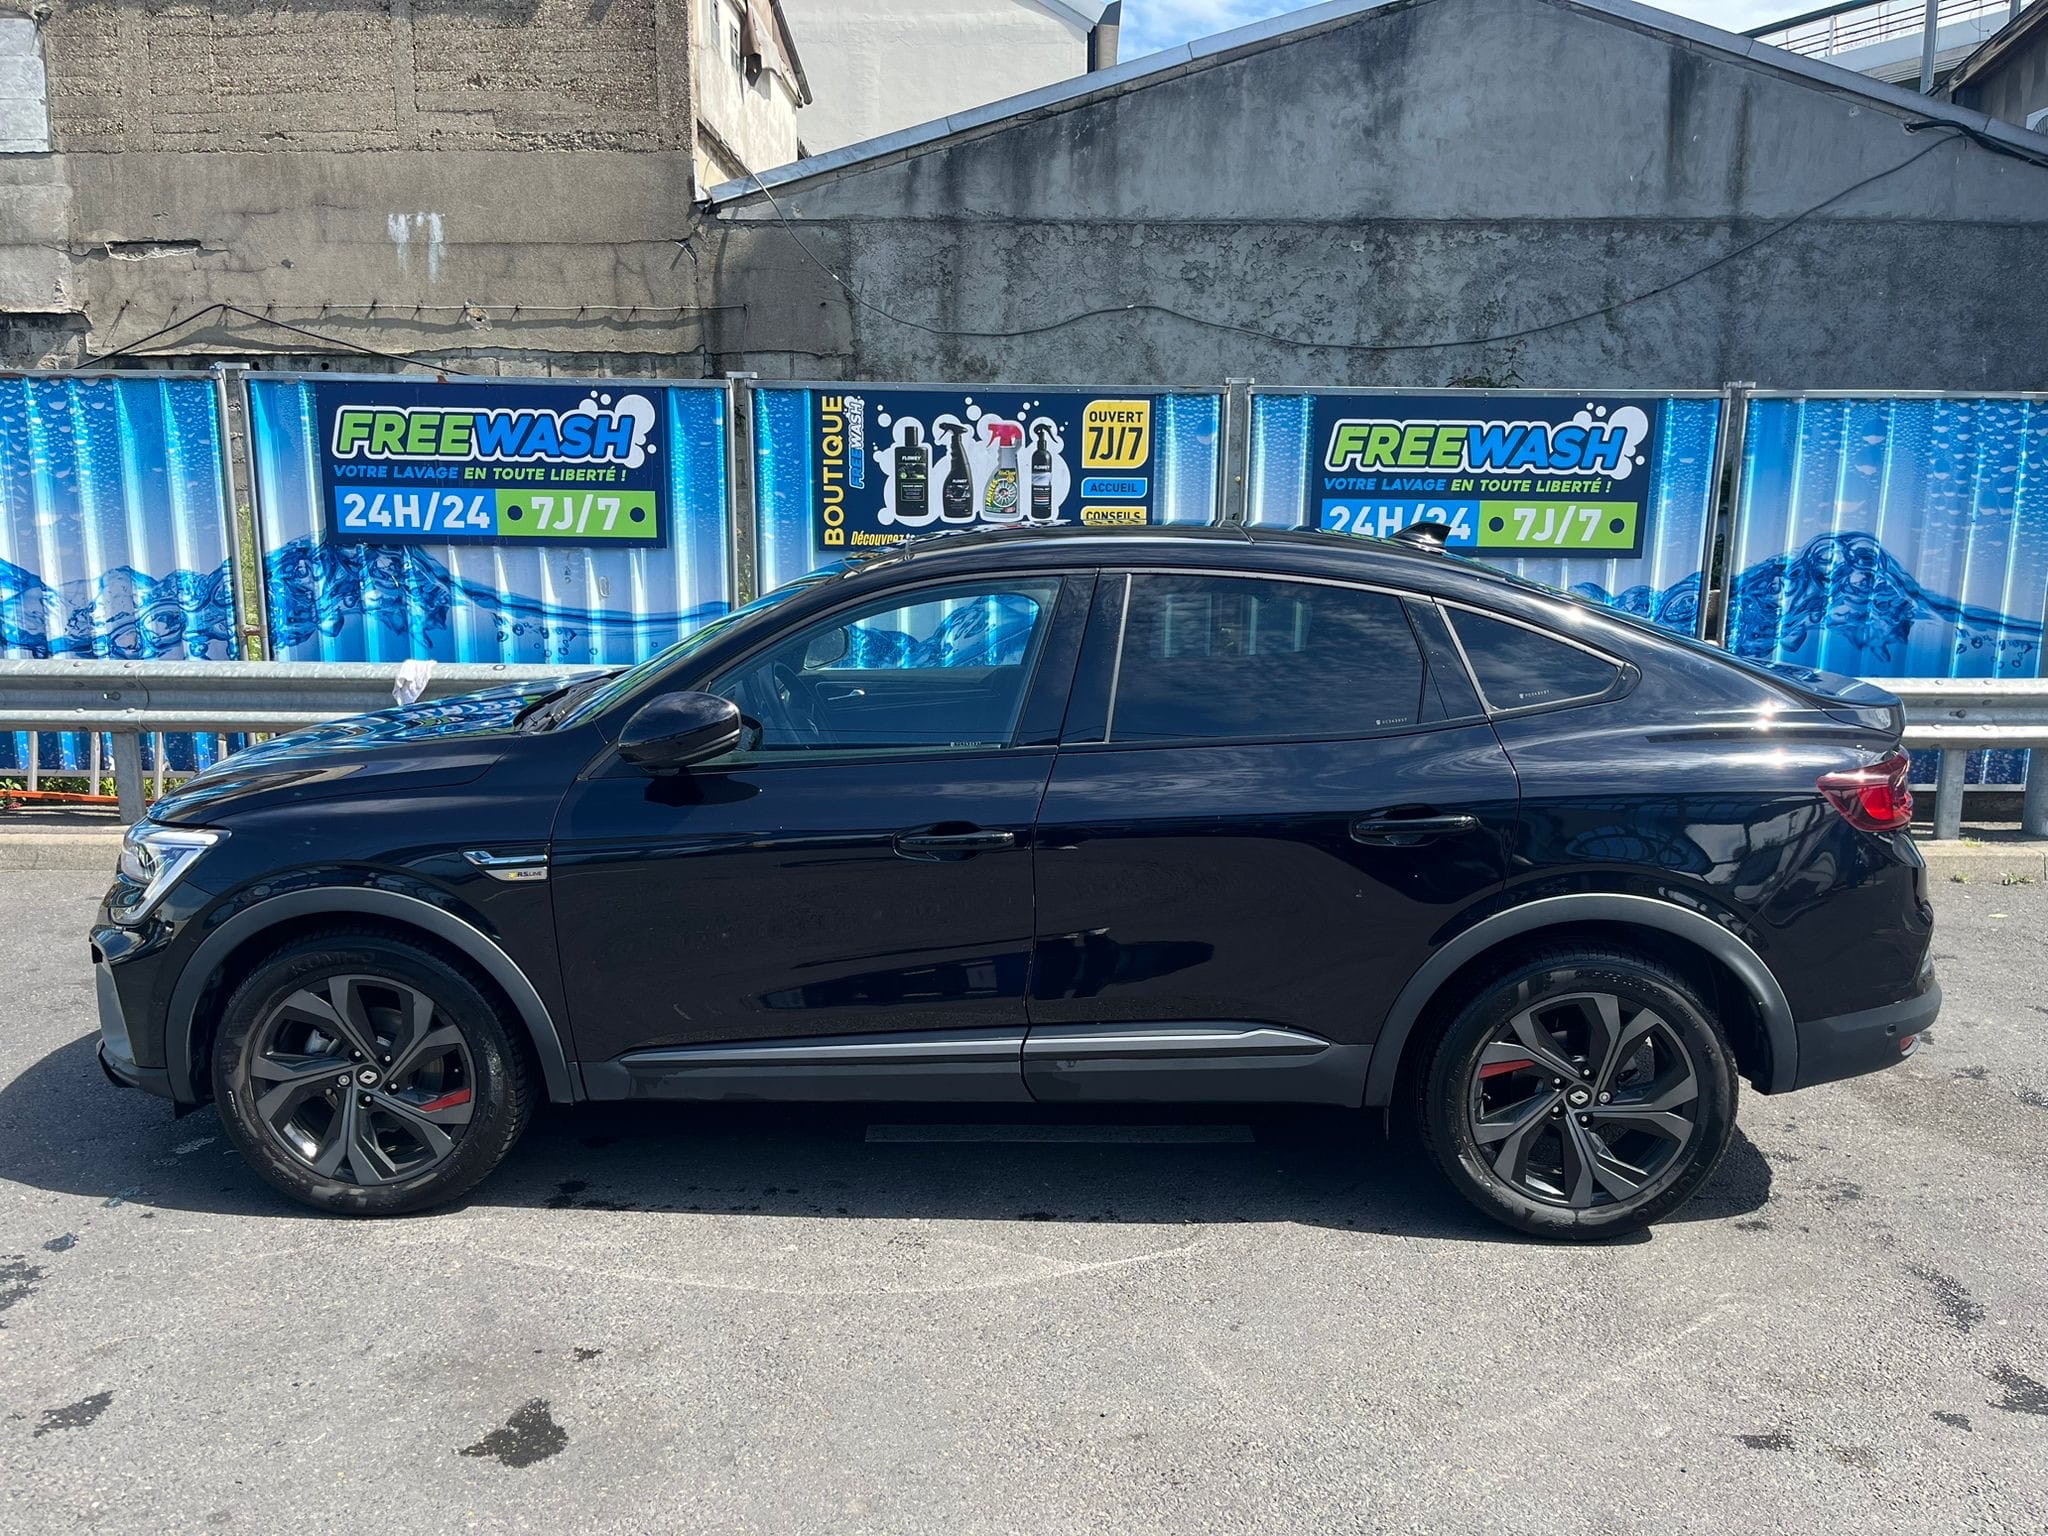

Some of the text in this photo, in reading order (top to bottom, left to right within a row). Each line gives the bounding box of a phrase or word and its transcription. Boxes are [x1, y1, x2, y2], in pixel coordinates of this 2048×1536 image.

[337, 410, 635, 458] FREEWASH
[1089, 411, 1143, 423] OUVERT
[849, 401, 863, 487] FREEWASH
[1088, 426, 1143, 461] 7J/7
[1331, 423, 1628, 471] FREEWASH
[334, 465, 627, 482] VOTRE LAVAGE EN TOUTE LIBERTÉ !
[822, 395, 845, 546] BOUTIQUE
[1090, 483, 1137, 493] ACCUEIL
[1324, 477, 1612, 493] VOTRE LAVAGE EN TOUTE LIBERTÉ !
[344, 491, 621, 534] 24H/24 7J/7
[1513, 506, 1602, 545] 7J/7
